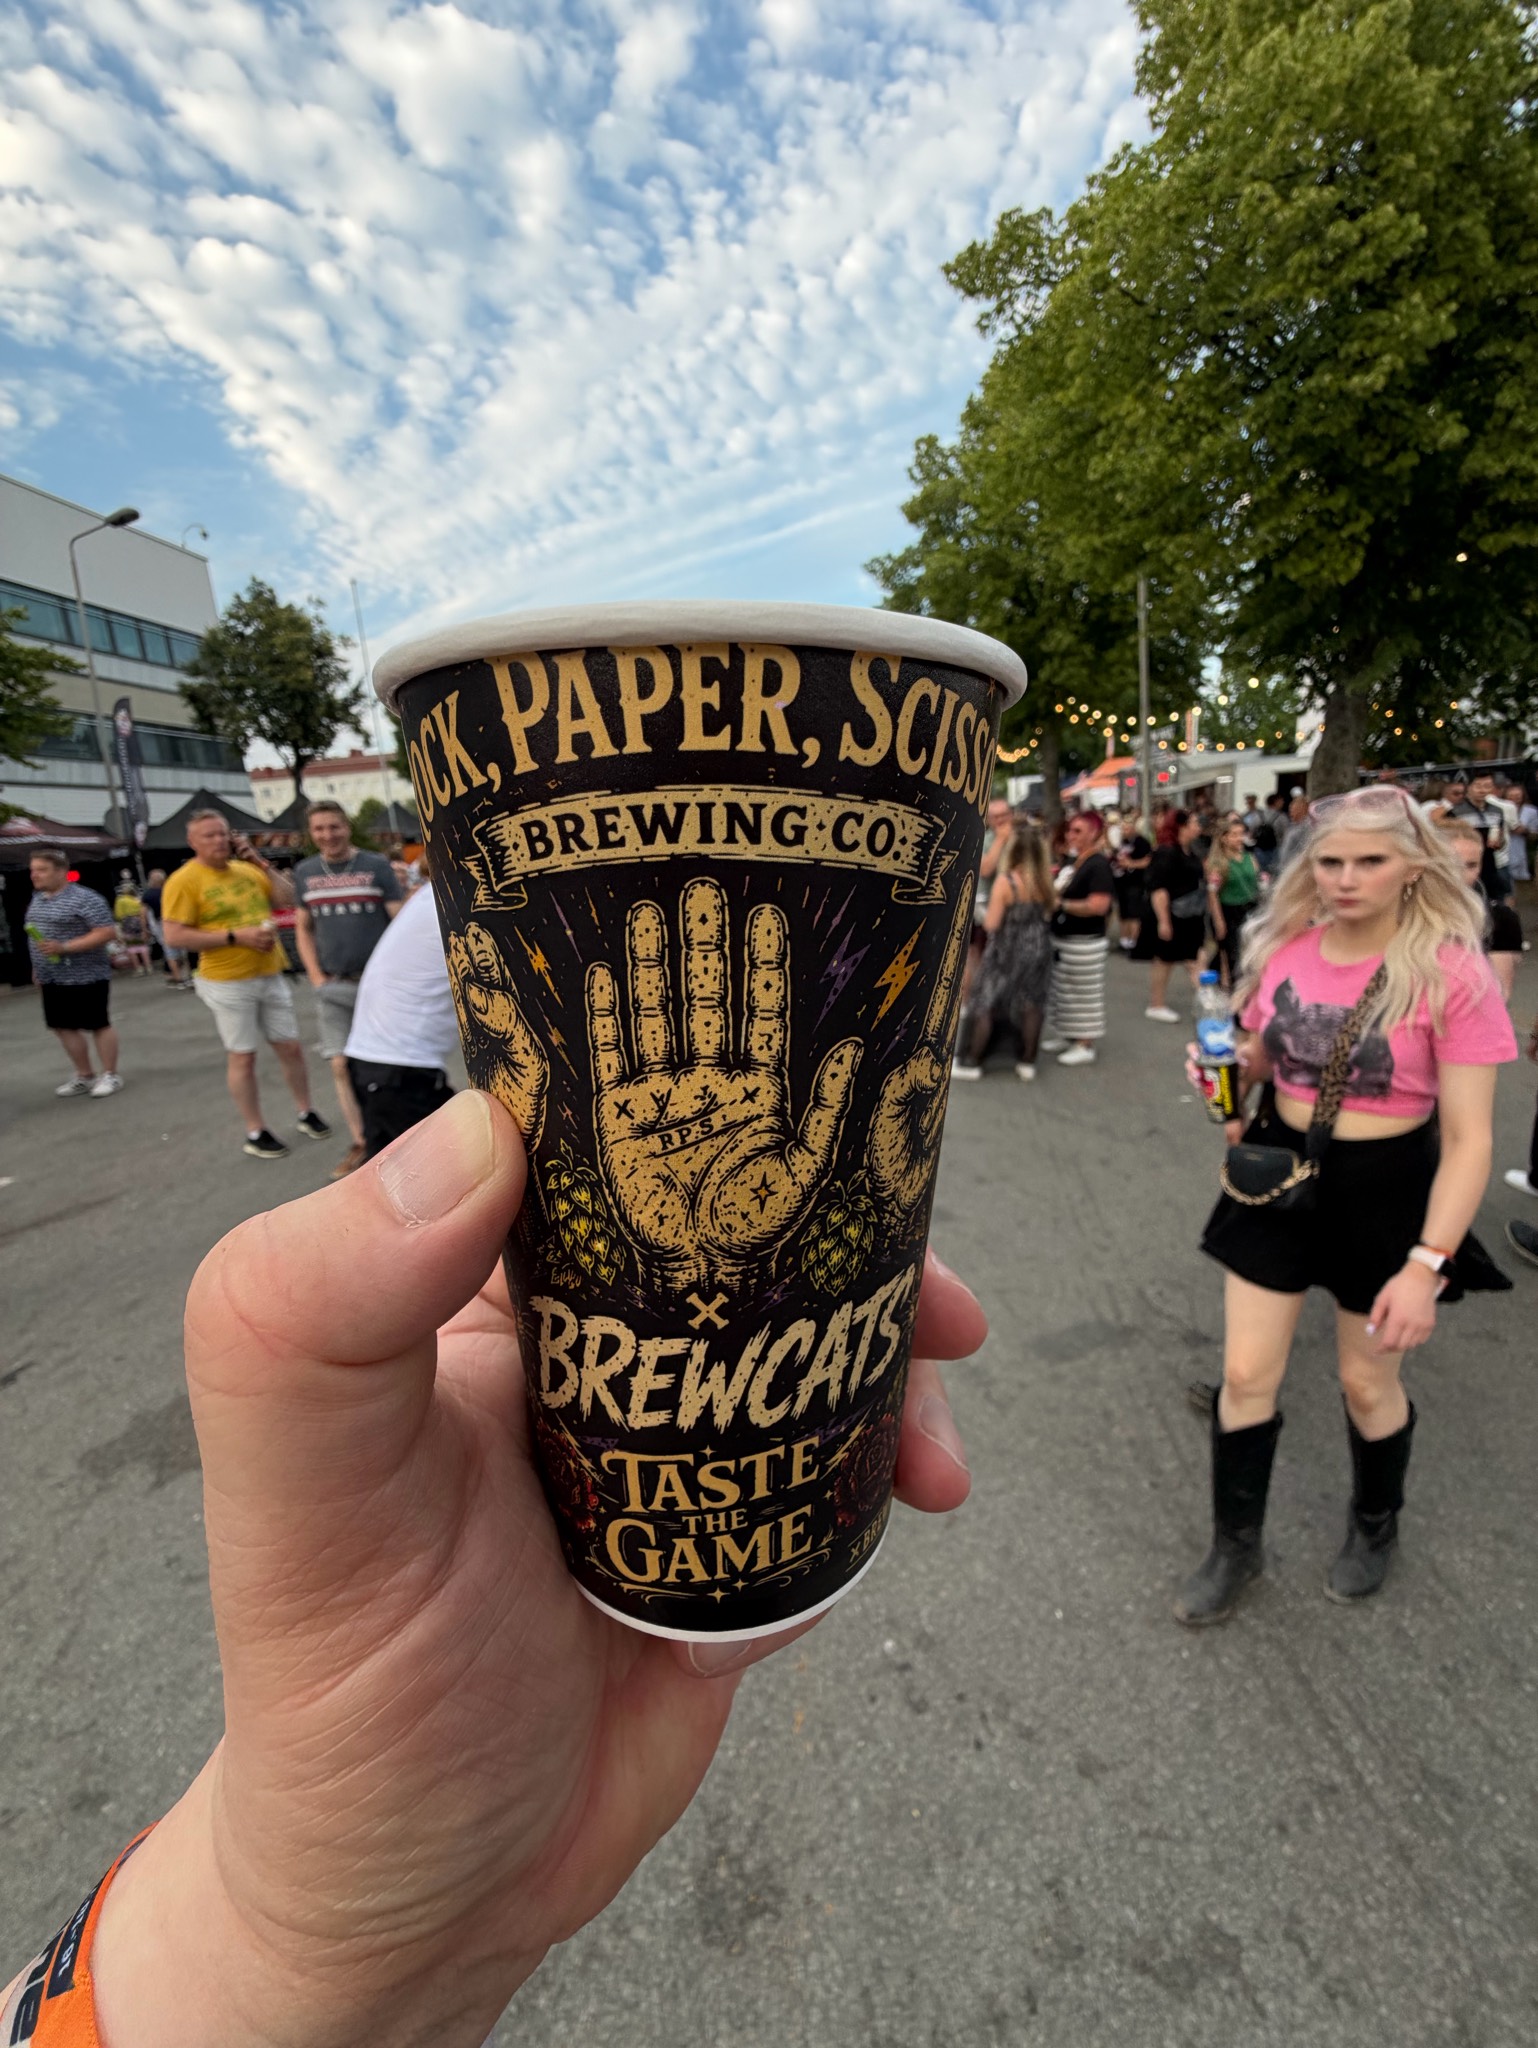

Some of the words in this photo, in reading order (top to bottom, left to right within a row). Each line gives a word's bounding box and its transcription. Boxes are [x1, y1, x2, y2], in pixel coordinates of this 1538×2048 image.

[410, 689, 501, 843] OCK,
[484, 642, 821, 775] PAPER,
[838, 650, 998, 826] SCISSO
[519, 801, 809, 862] BREWING
[658, 1117, 714, 1151] RPS
[528, 1262, 917, 1434] BREWCATS
[601, 1435, 821, 1514] TASTE
[605, 1503, 814, 1584] GAME
[682, 1508, 749, 1536] THE
